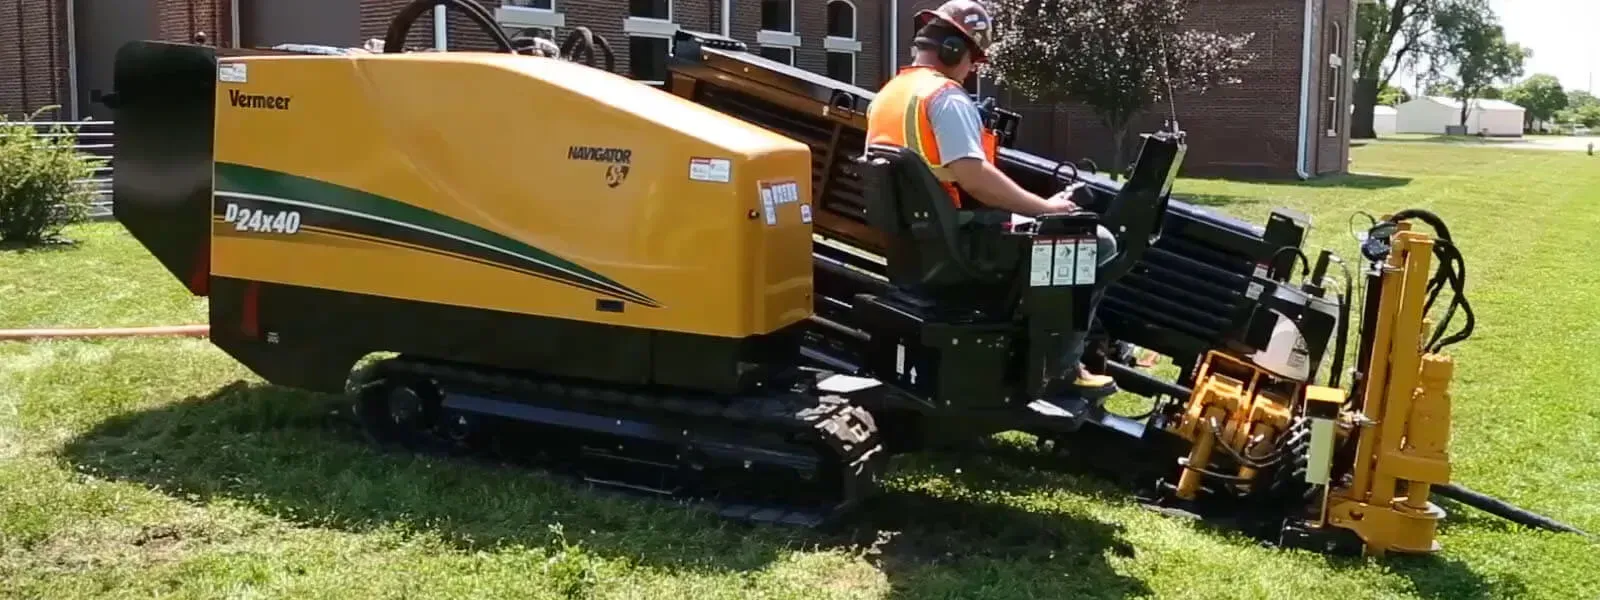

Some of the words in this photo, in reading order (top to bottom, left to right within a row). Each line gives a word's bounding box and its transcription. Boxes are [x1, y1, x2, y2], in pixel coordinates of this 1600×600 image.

[229, 89, 291, 109] Vermeer
[567, 145, 631, 163] NAVIGATOR
[225, 203, 300, 234] D24x40
